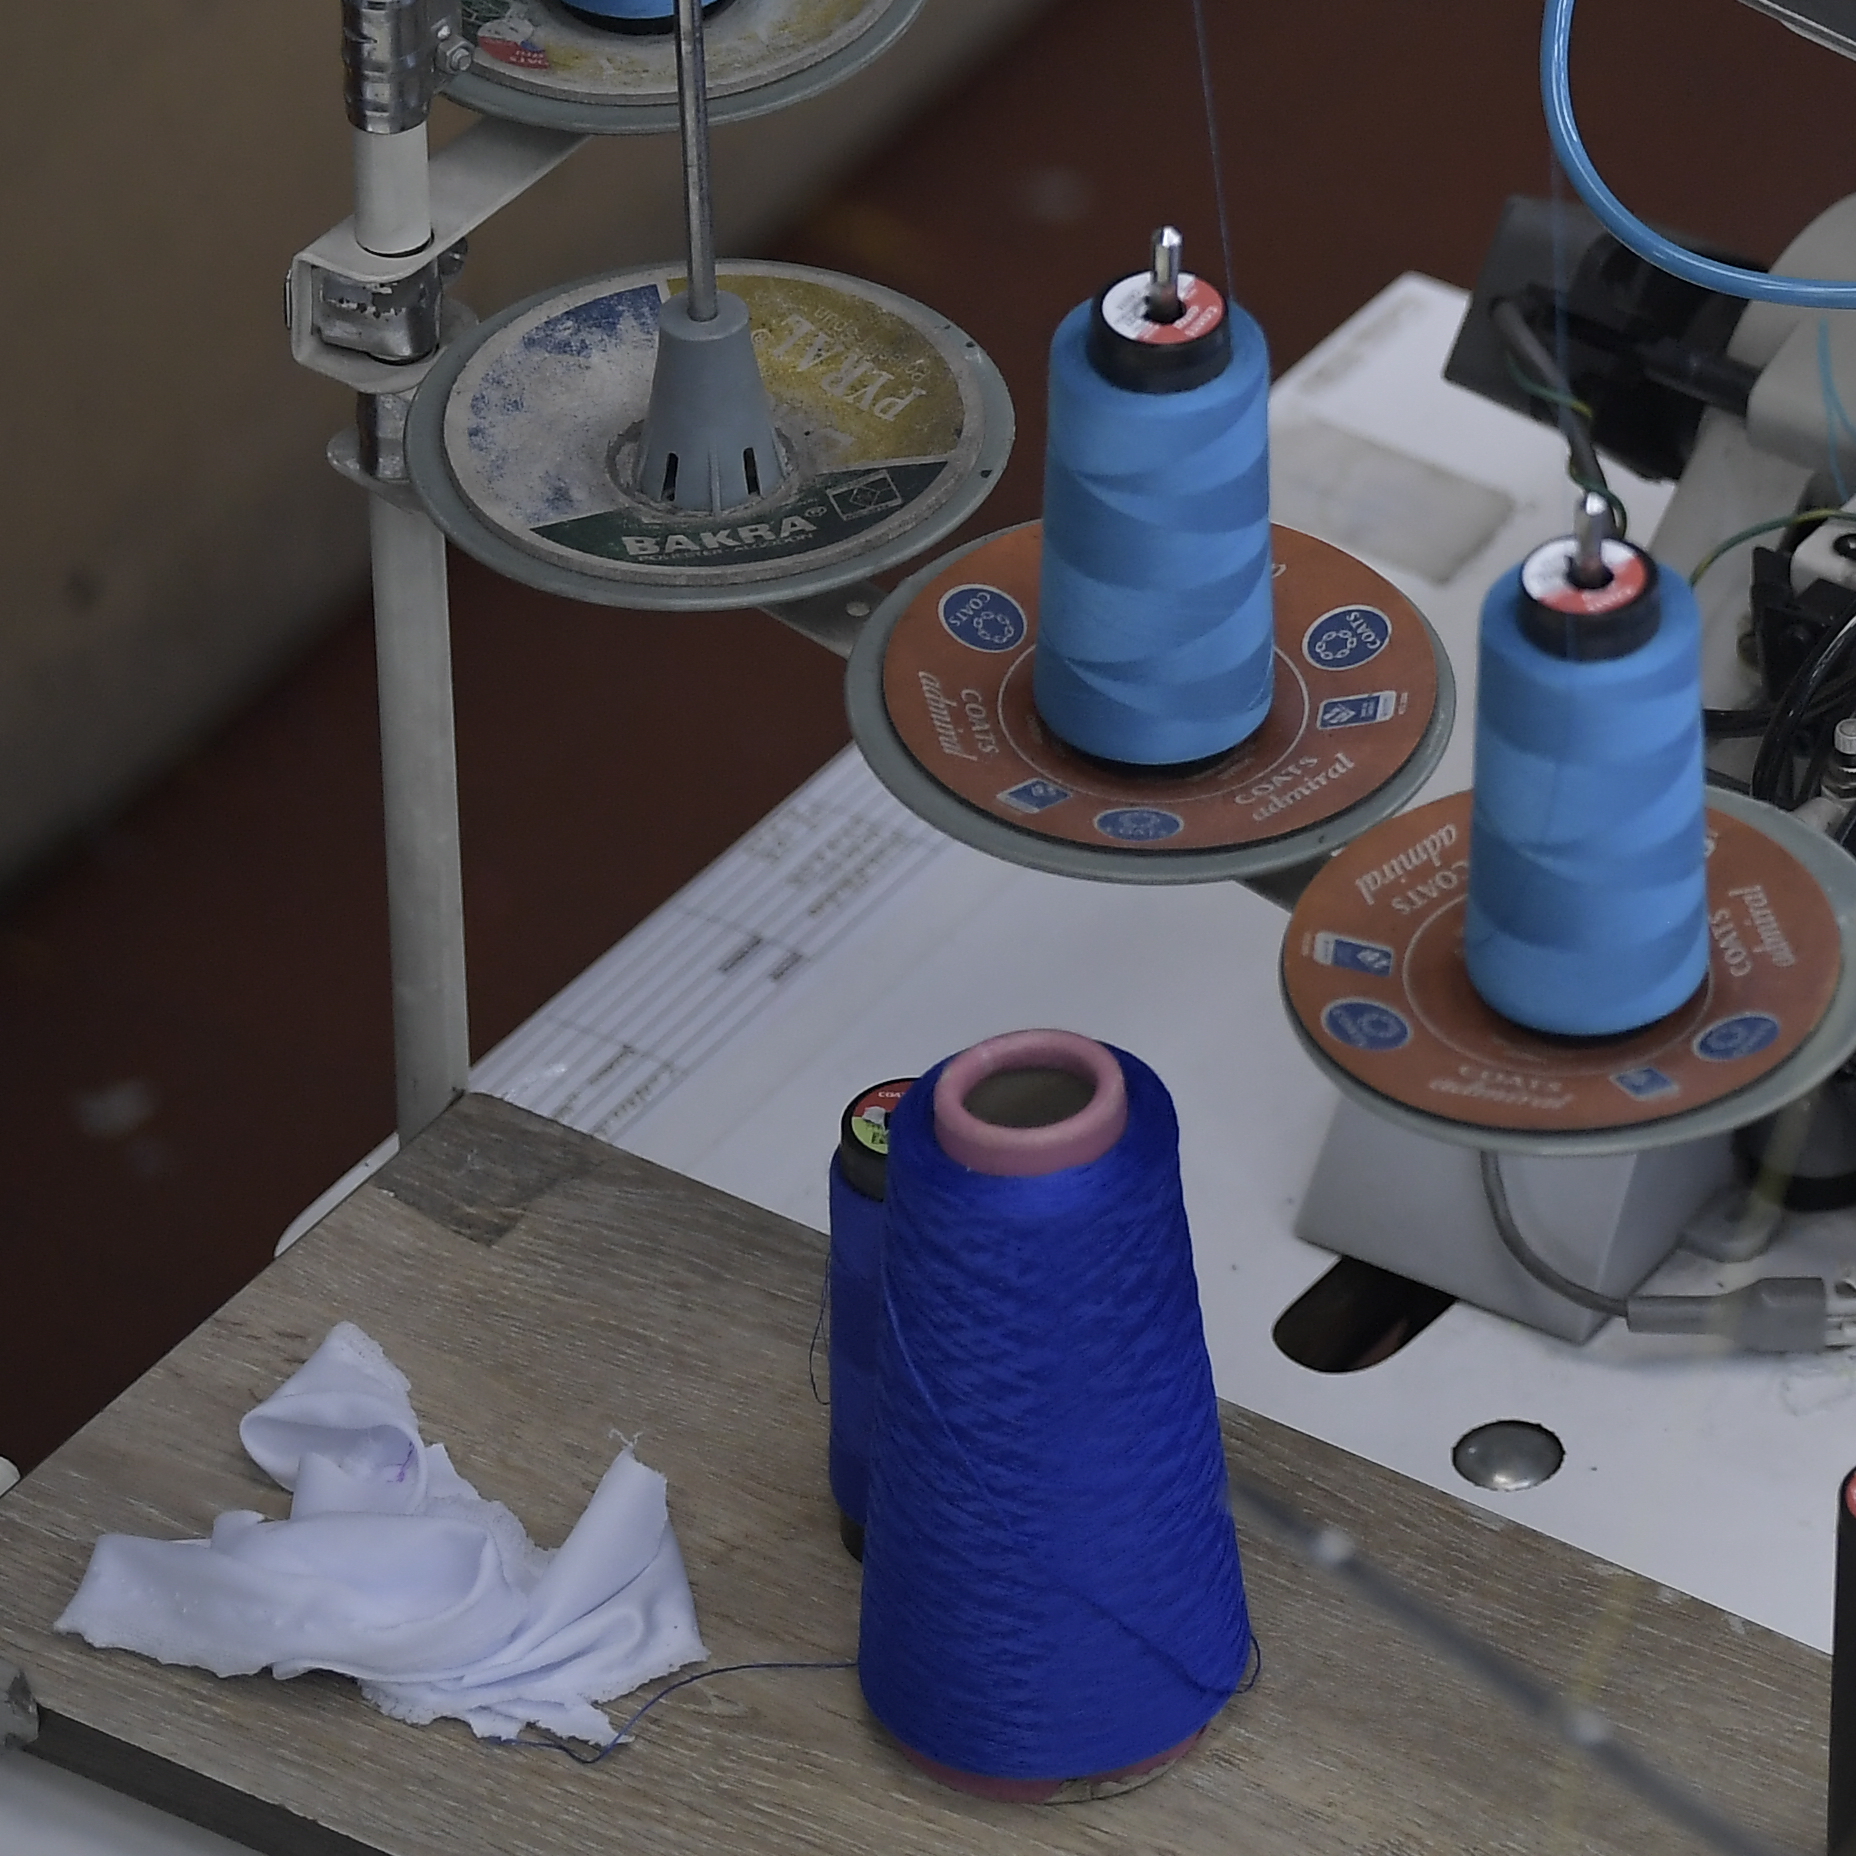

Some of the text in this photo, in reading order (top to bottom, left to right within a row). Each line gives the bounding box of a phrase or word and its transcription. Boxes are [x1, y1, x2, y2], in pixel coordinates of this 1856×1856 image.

[772, 313, 927, 422] PYRAL
[621, 515, 817, 556] BAKRA
[948, 592, 991, 627] COATS
[1346, 611, 1381, 650] COATS
[918, 670, 978, 761] admiral
[960, 689, 1000, 753] COATS
[1235, 756, 1319, 805] COATS
[1252, 752, 1355, 822] admiral
[1355, 824, 1457, 905] admiral
[1710, 908, 1752, 978] COATS
[1728, 885, 1796, 968] admiral
